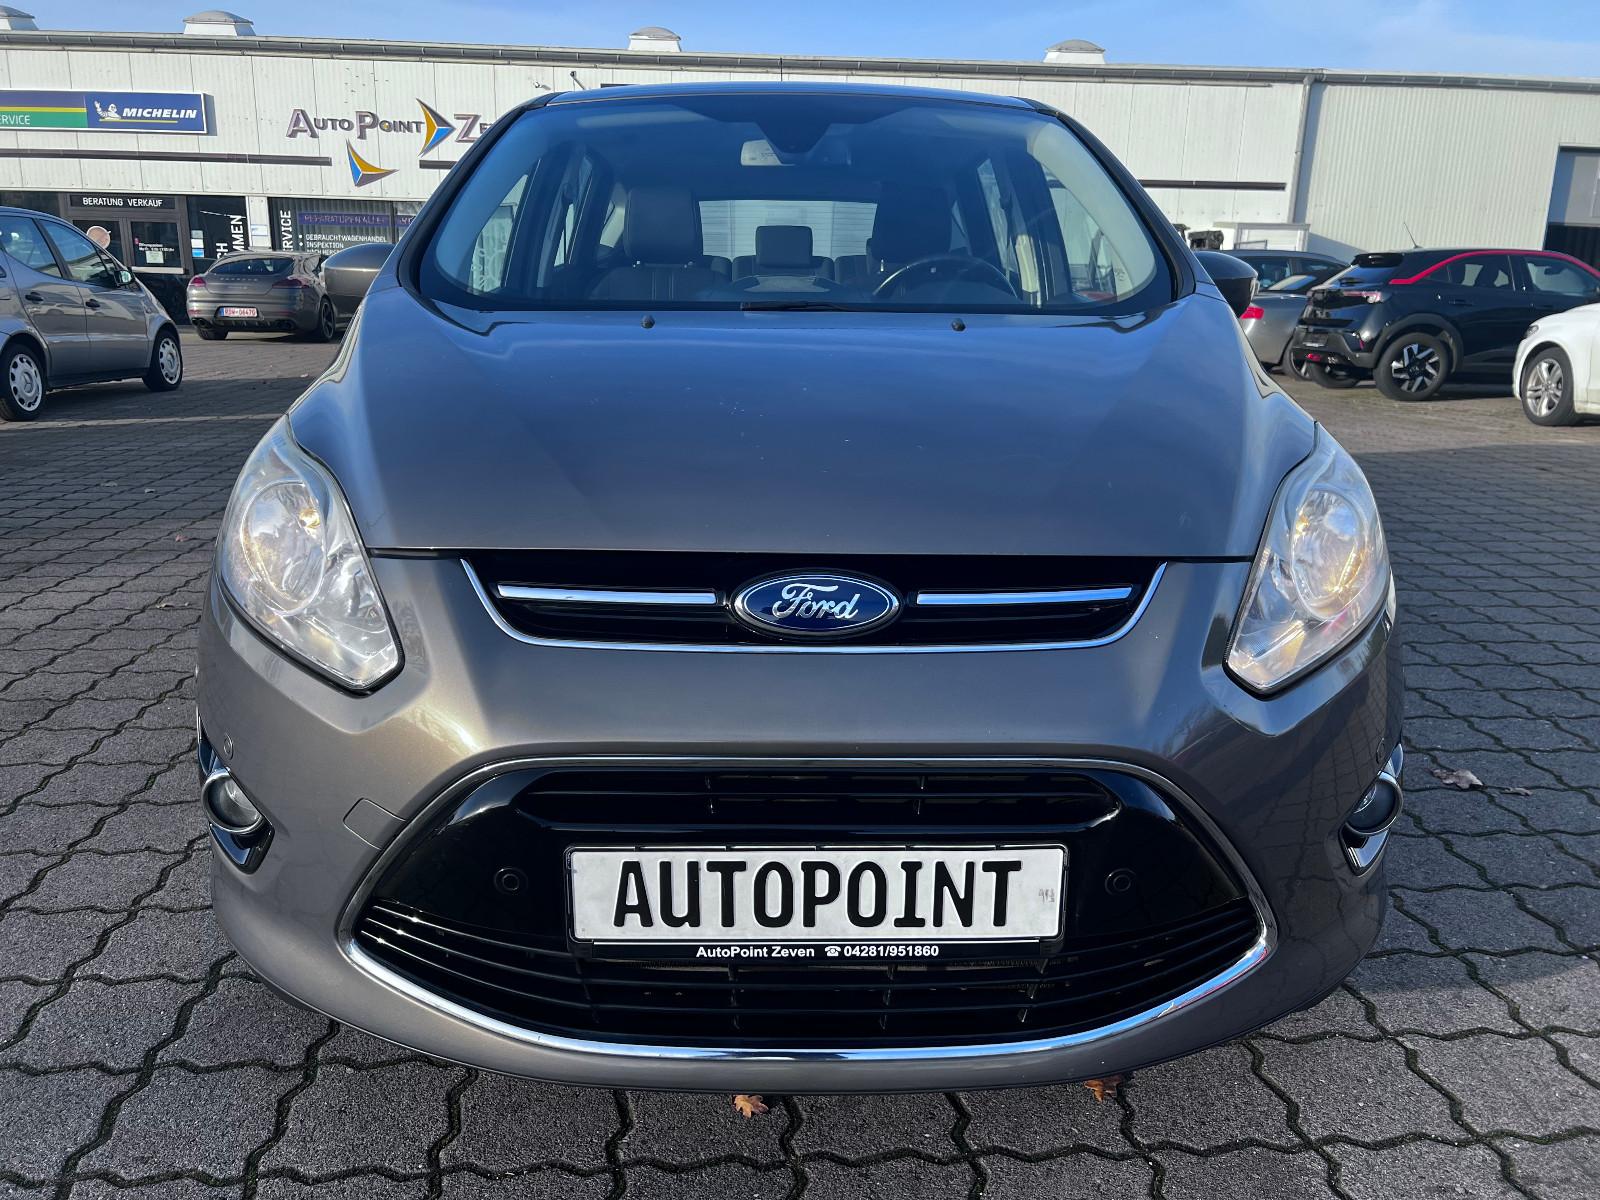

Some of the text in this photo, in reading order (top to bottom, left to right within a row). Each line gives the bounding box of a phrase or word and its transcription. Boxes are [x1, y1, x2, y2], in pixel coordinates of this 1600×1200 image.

[122, 107, 197, 119] MICHELIN
[82, 197, 163, 207] BERATUNG VERKAUF
[772, 582, 861, 619] Ford
[612, 860, 1022, 928] AUTOPOINT
[696, 945, 940, 958] AutoPoint Zeven 04281/951860
